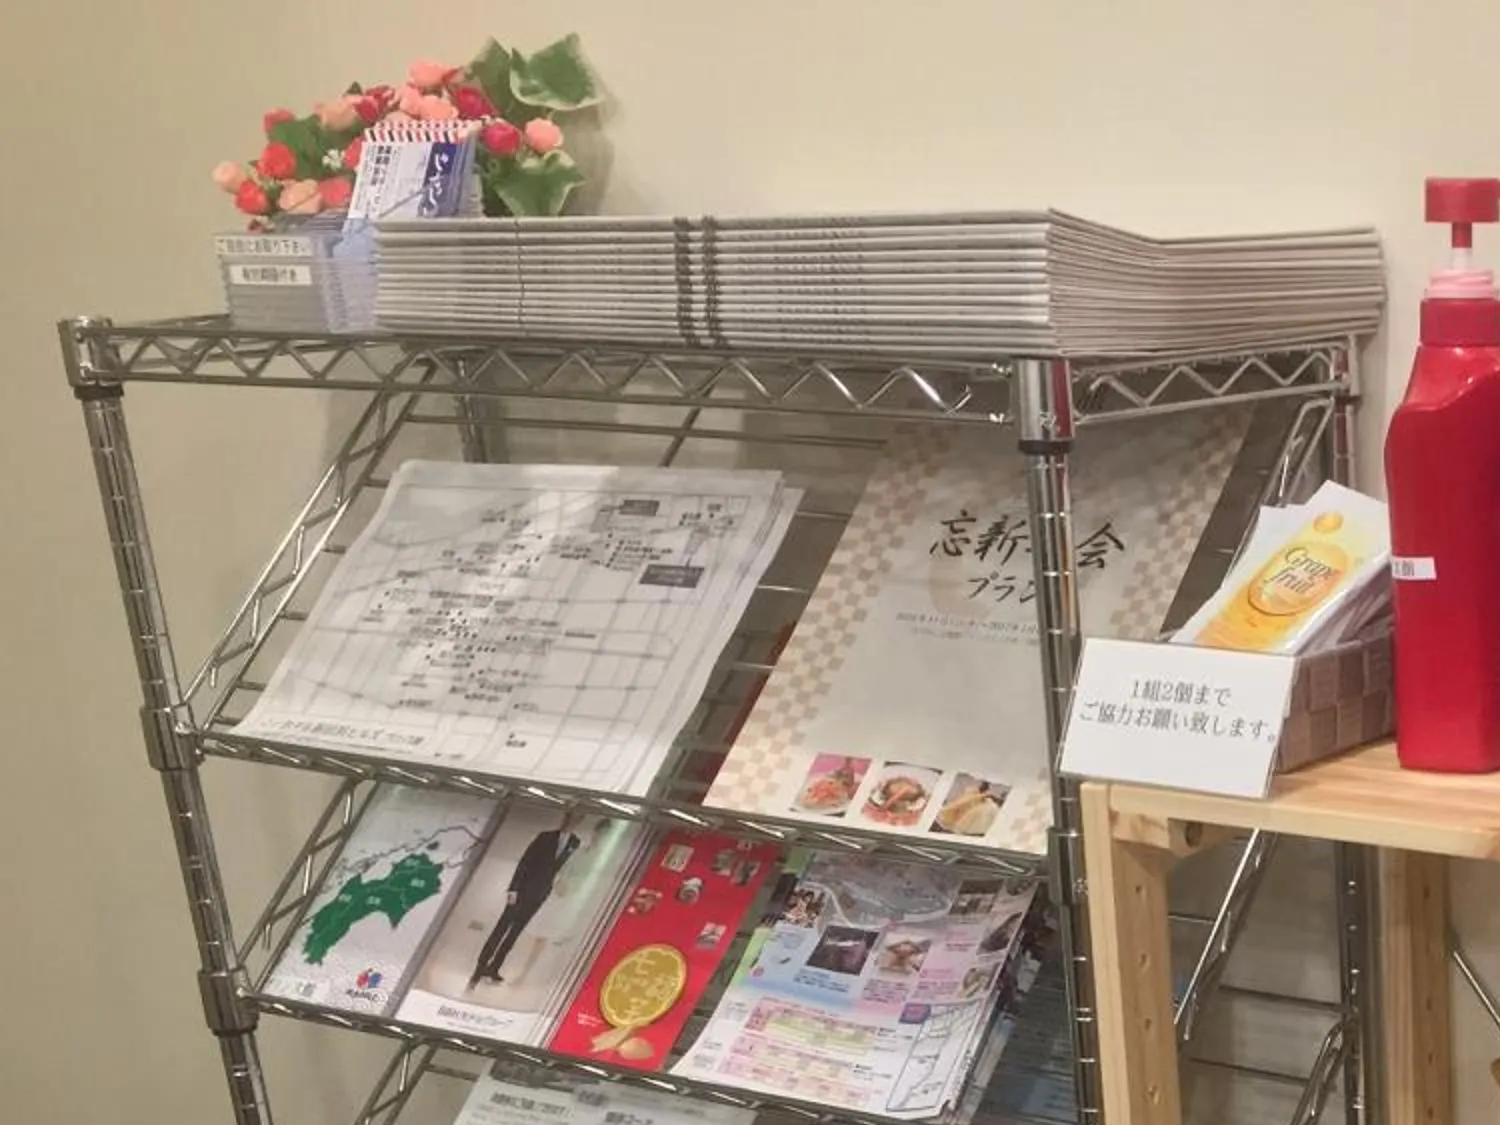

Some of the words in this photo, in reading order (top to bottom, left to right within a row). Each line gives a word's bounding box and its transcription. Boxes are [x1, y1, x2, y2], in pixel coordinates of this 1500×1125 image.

[929, 509, 1125, 570] 忘新会
[1131, 679, 1232, 708] 1組2個まで
[1078, 699, 1276, 744] ご協力お願い致します。
